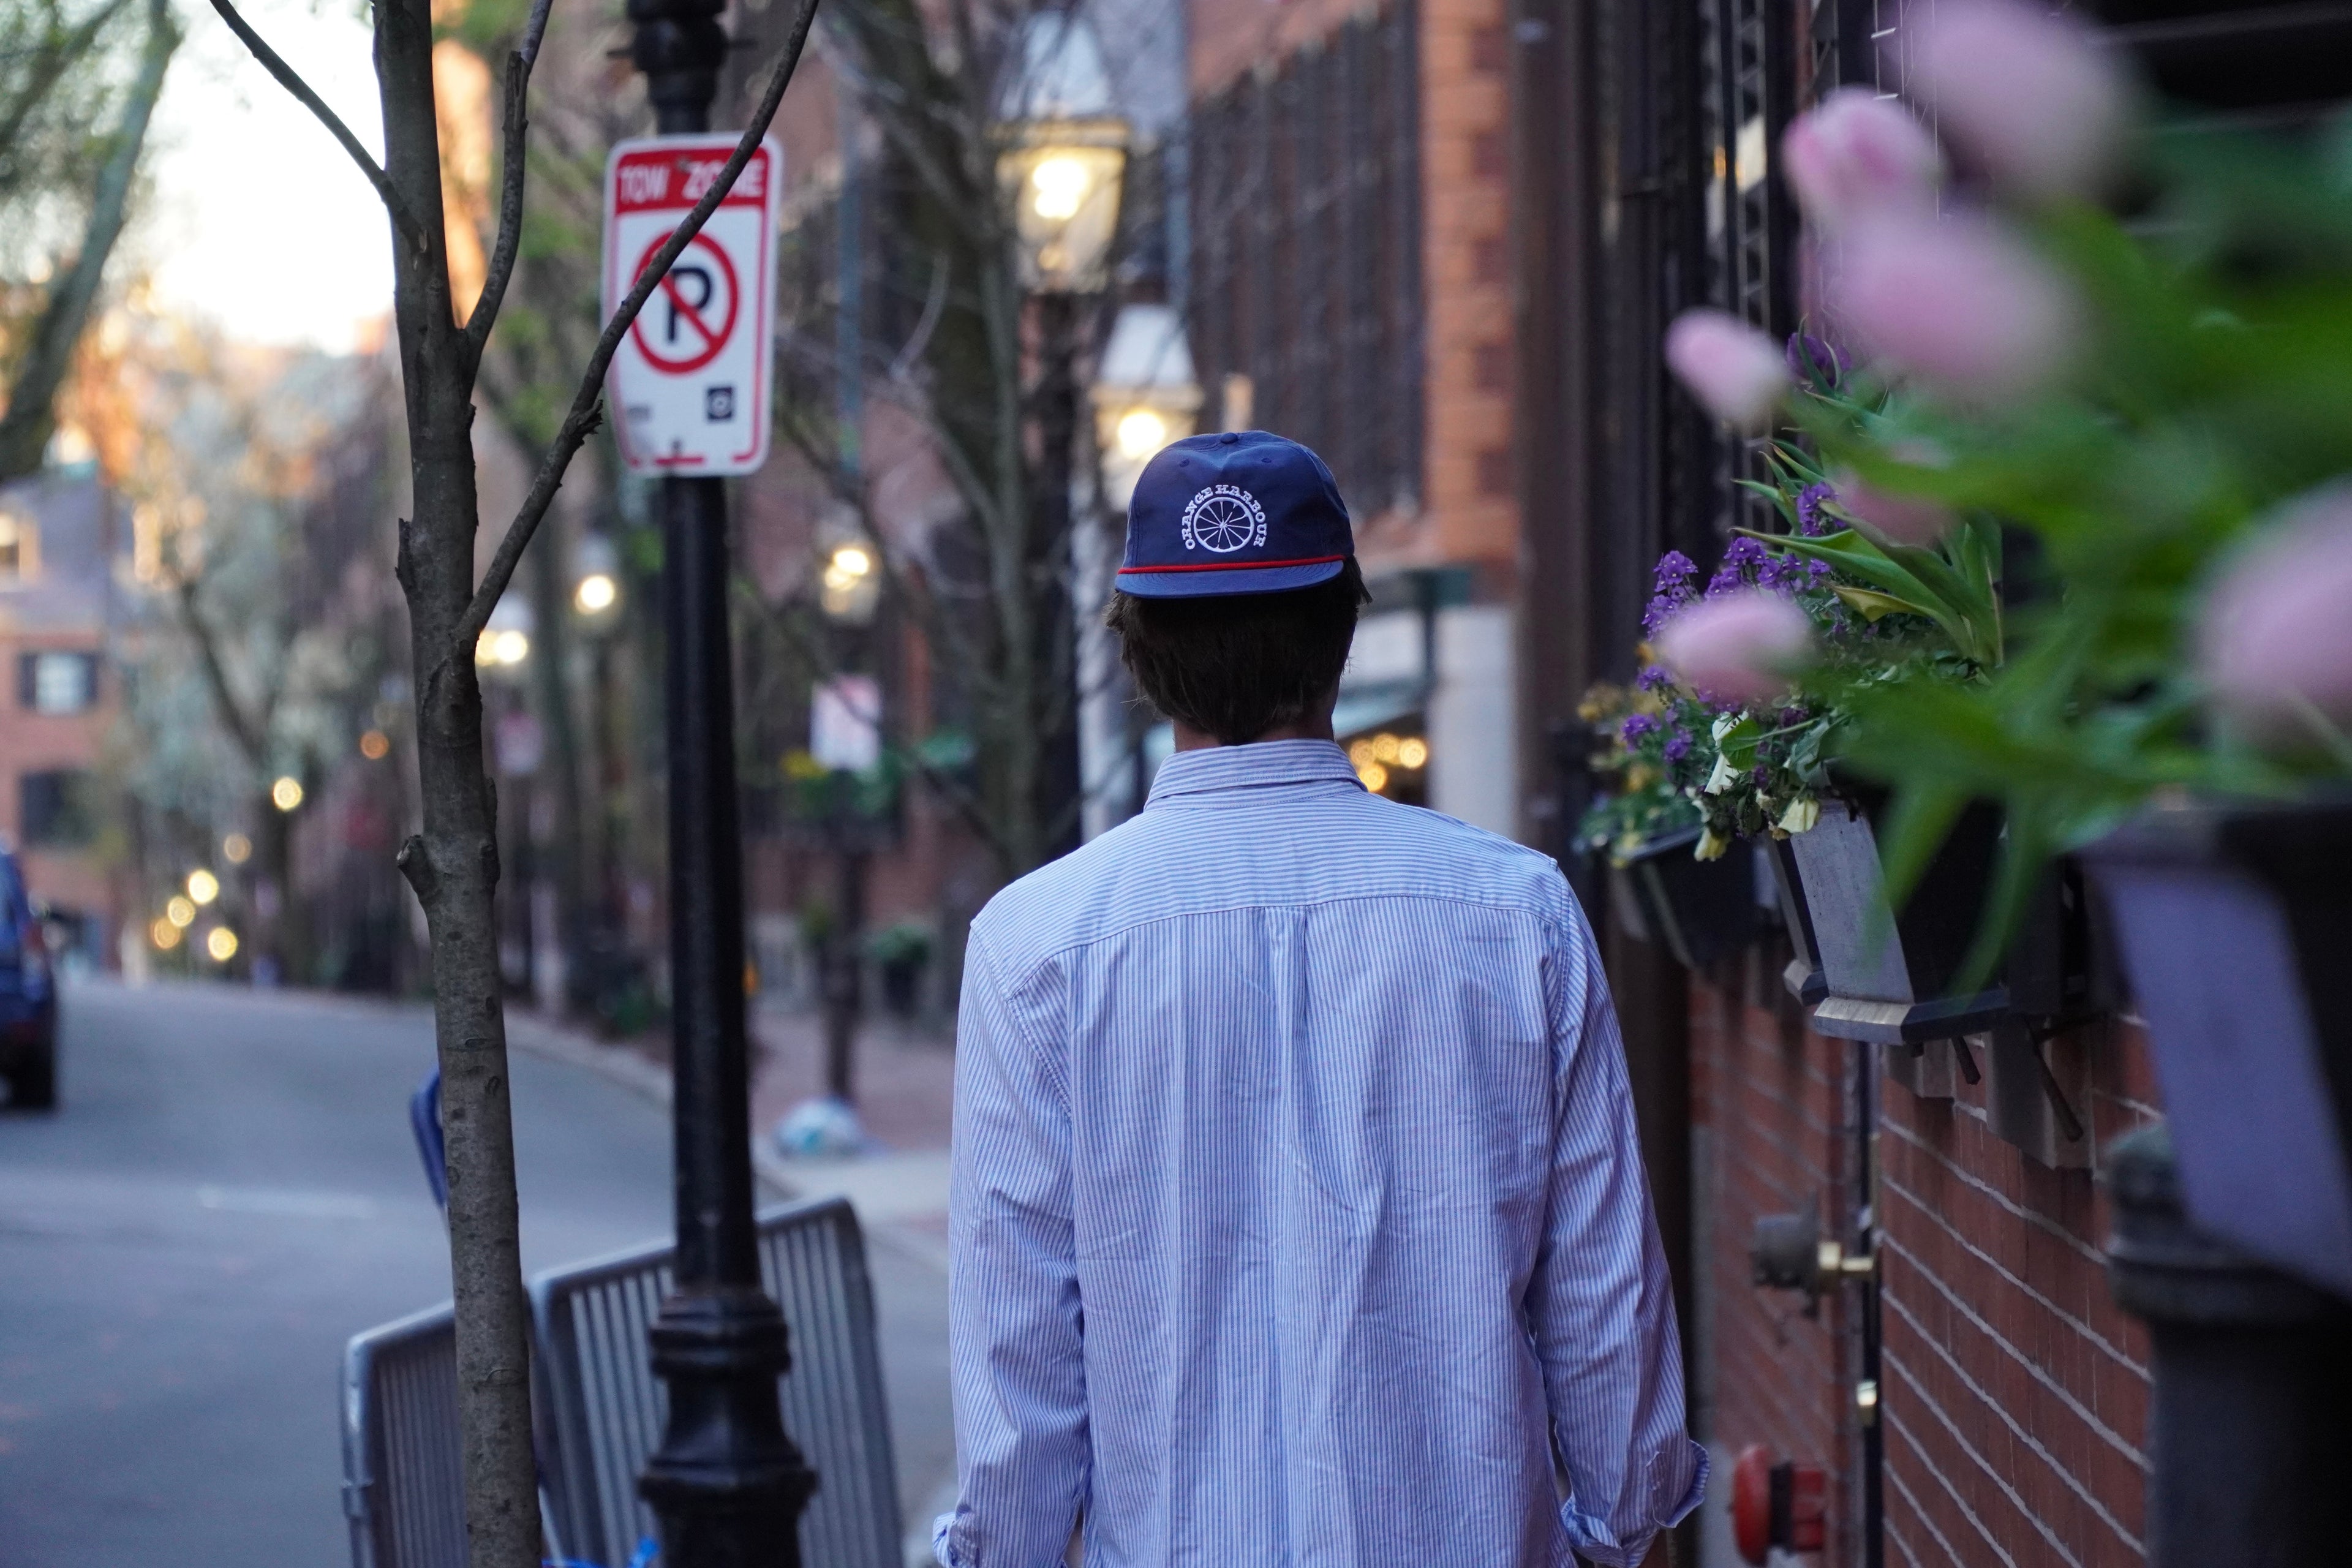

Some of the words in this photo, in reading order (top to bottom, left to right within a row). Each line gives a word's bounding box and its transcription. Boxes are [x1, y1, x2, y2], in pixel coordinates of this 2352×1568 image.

[619, 164, 669, 203] TOW
[1182, 487, 1213, 549] ORANGE
[1215, 484, 1267, 547] HARBOUR
